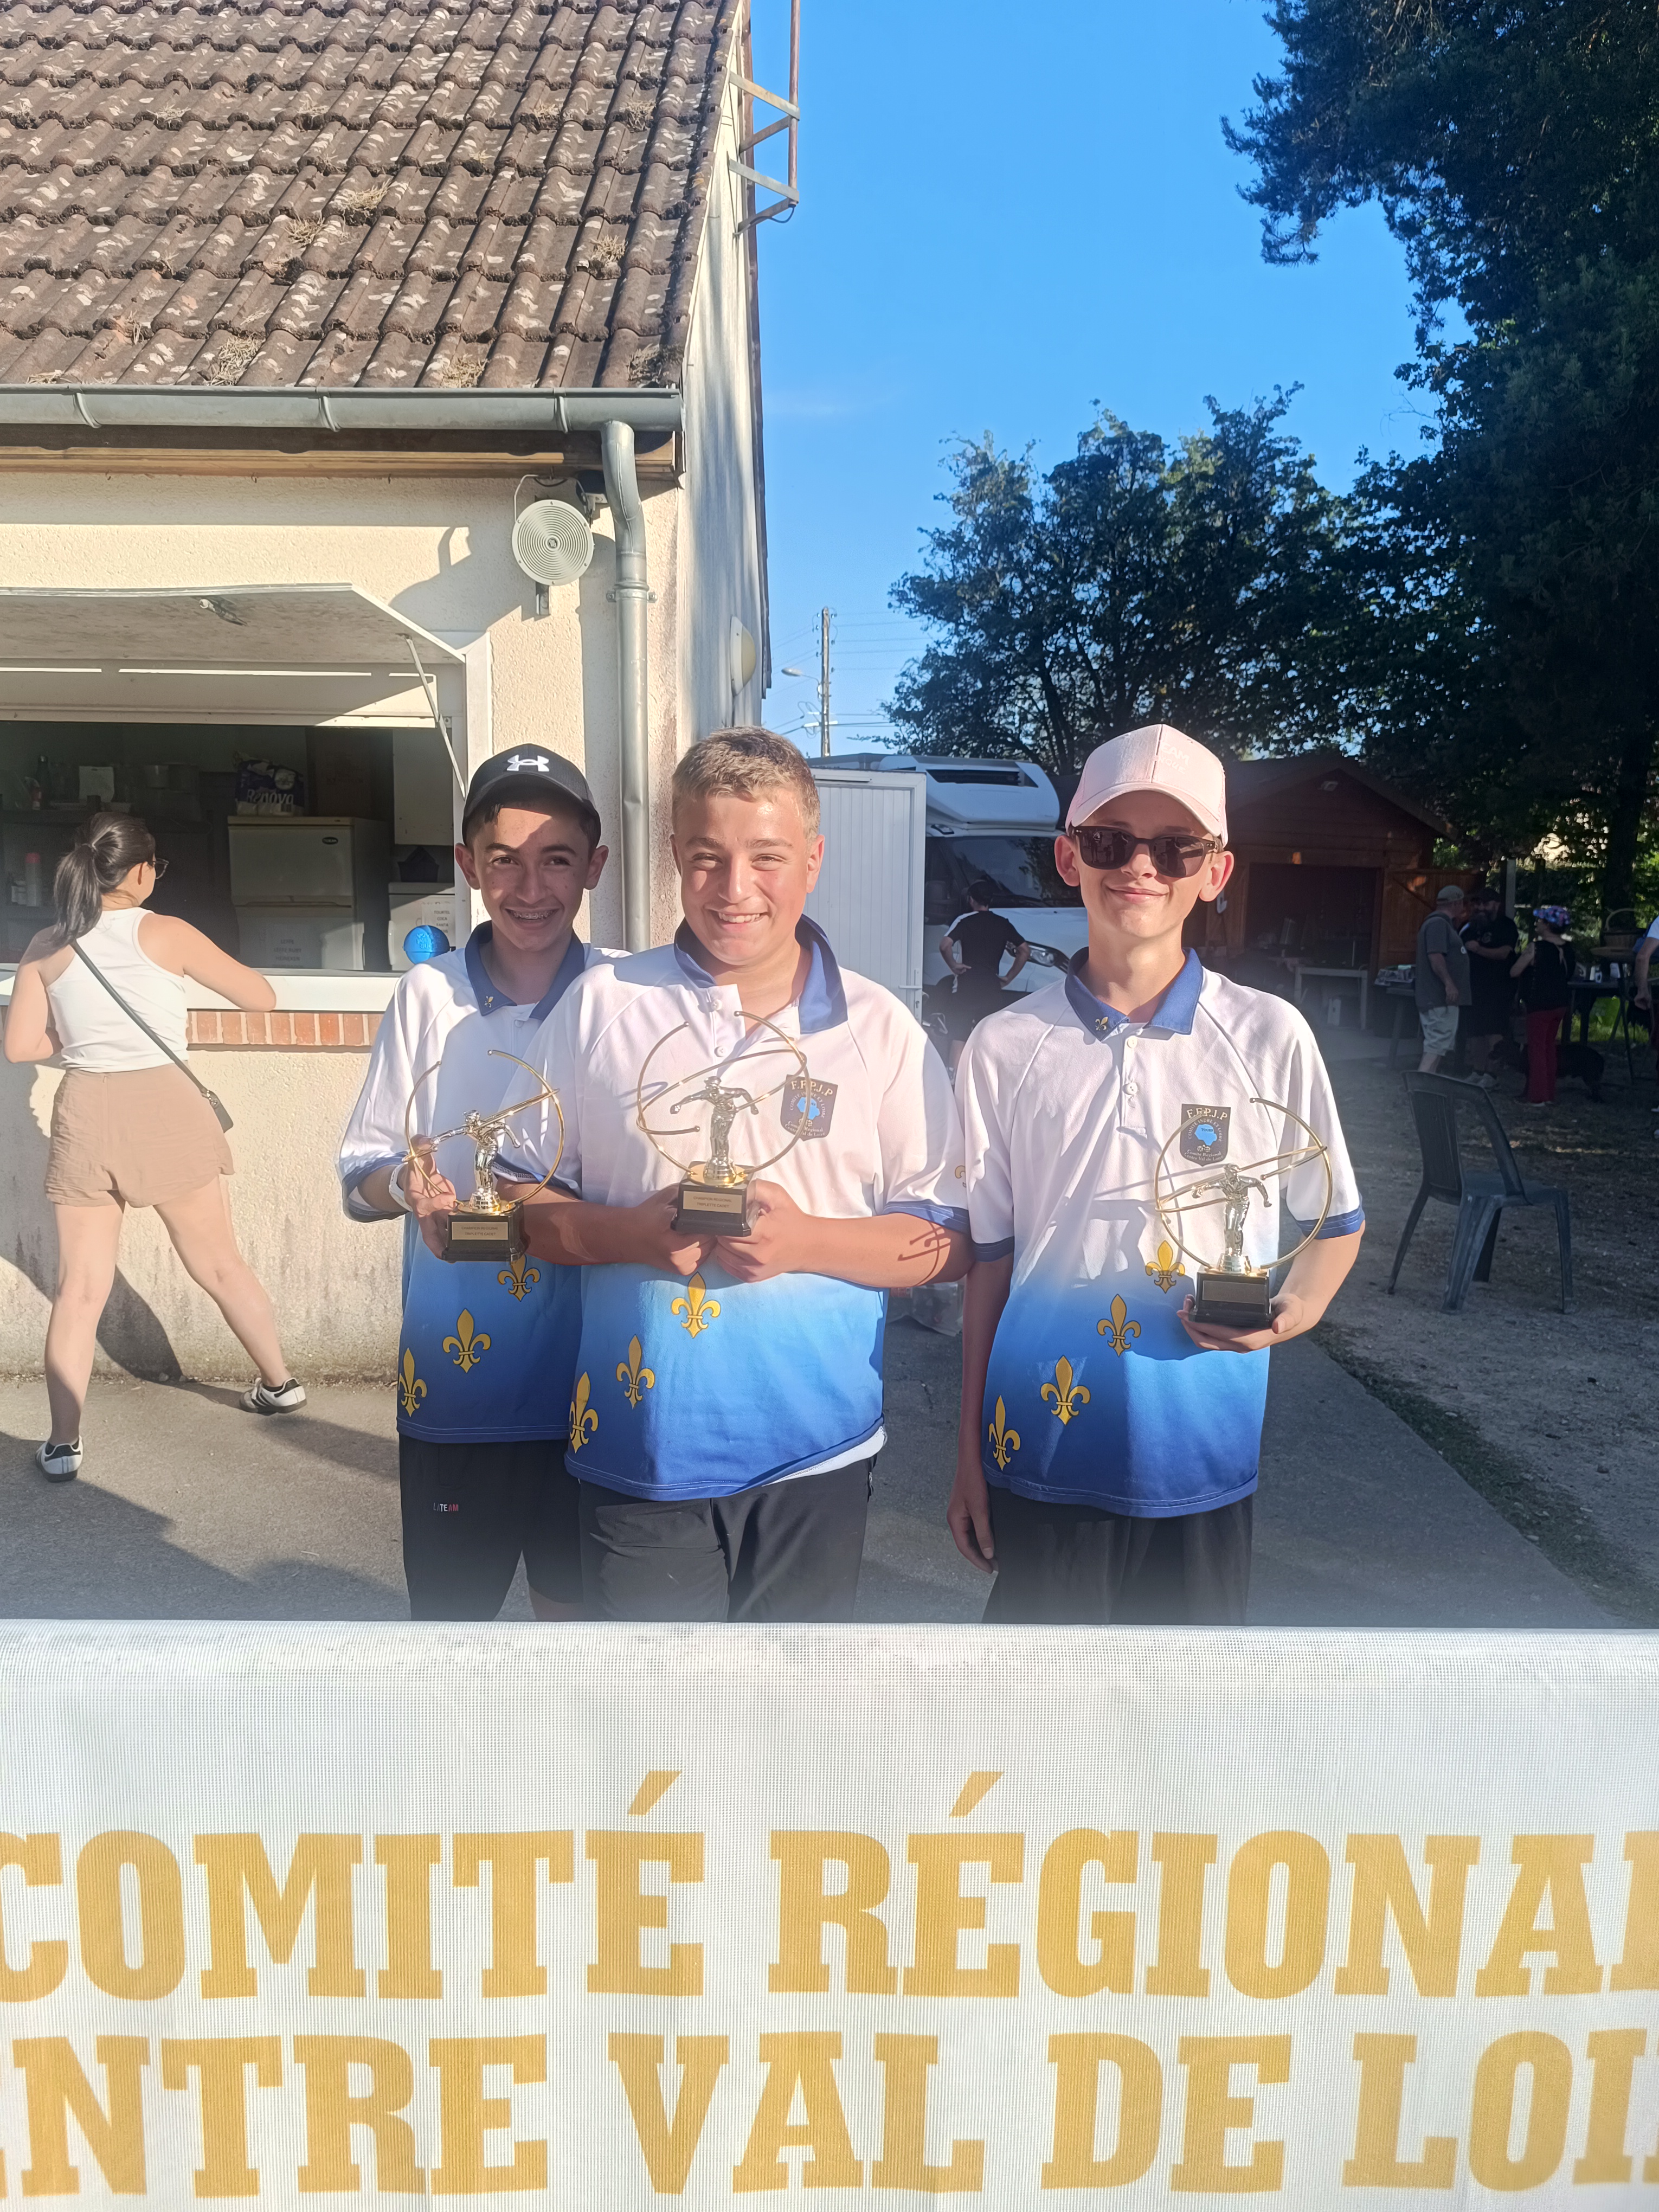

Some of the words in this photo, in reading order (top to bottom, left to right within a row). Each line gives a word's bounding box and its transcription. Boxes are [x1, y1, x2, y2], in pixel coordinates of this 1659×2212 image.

[247, 789, 294, 805] Renova
[0, 1771, 704, 2003] COMITÉ
[0, 2034, 548, 2199] NTRE
[607, 2031, 985, 2195] VAL
[1041, 2033, 1291, 2194] DE
[1343, 2029, 1659, 2191] LOI
